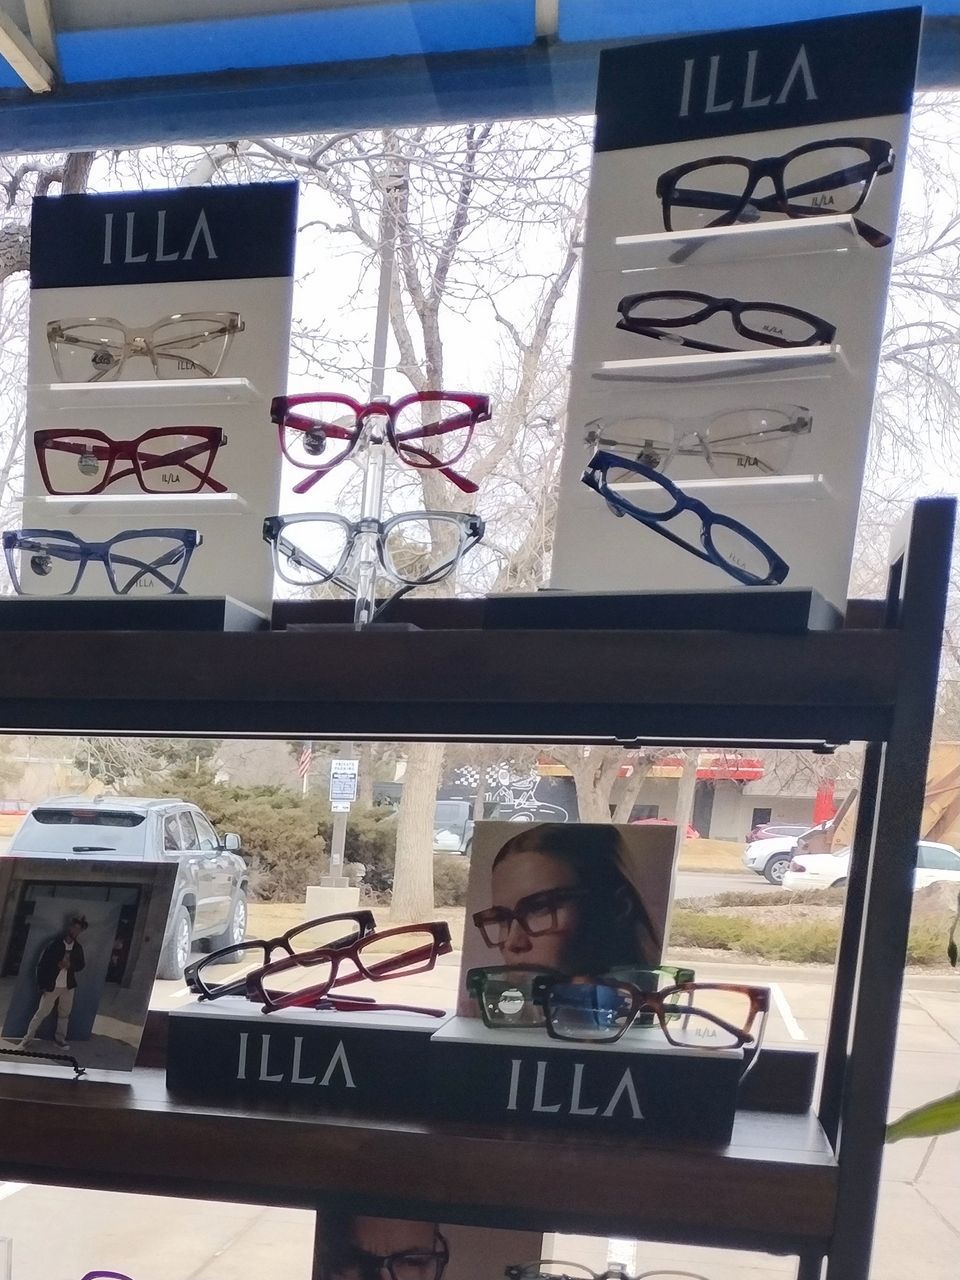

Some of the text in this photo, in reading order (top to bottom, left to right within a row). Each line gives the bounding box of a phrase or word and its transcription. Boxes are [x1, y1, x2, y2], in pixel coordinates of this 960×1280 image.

[679, 43, 818, 117] ILLA
[103, 207, 219, 264] ILLA
[161, 474, 180, 484] IL/LA
[237, 1032, 356, 1088] ILLA
[507, 1059, 645, 1119] ILLA
